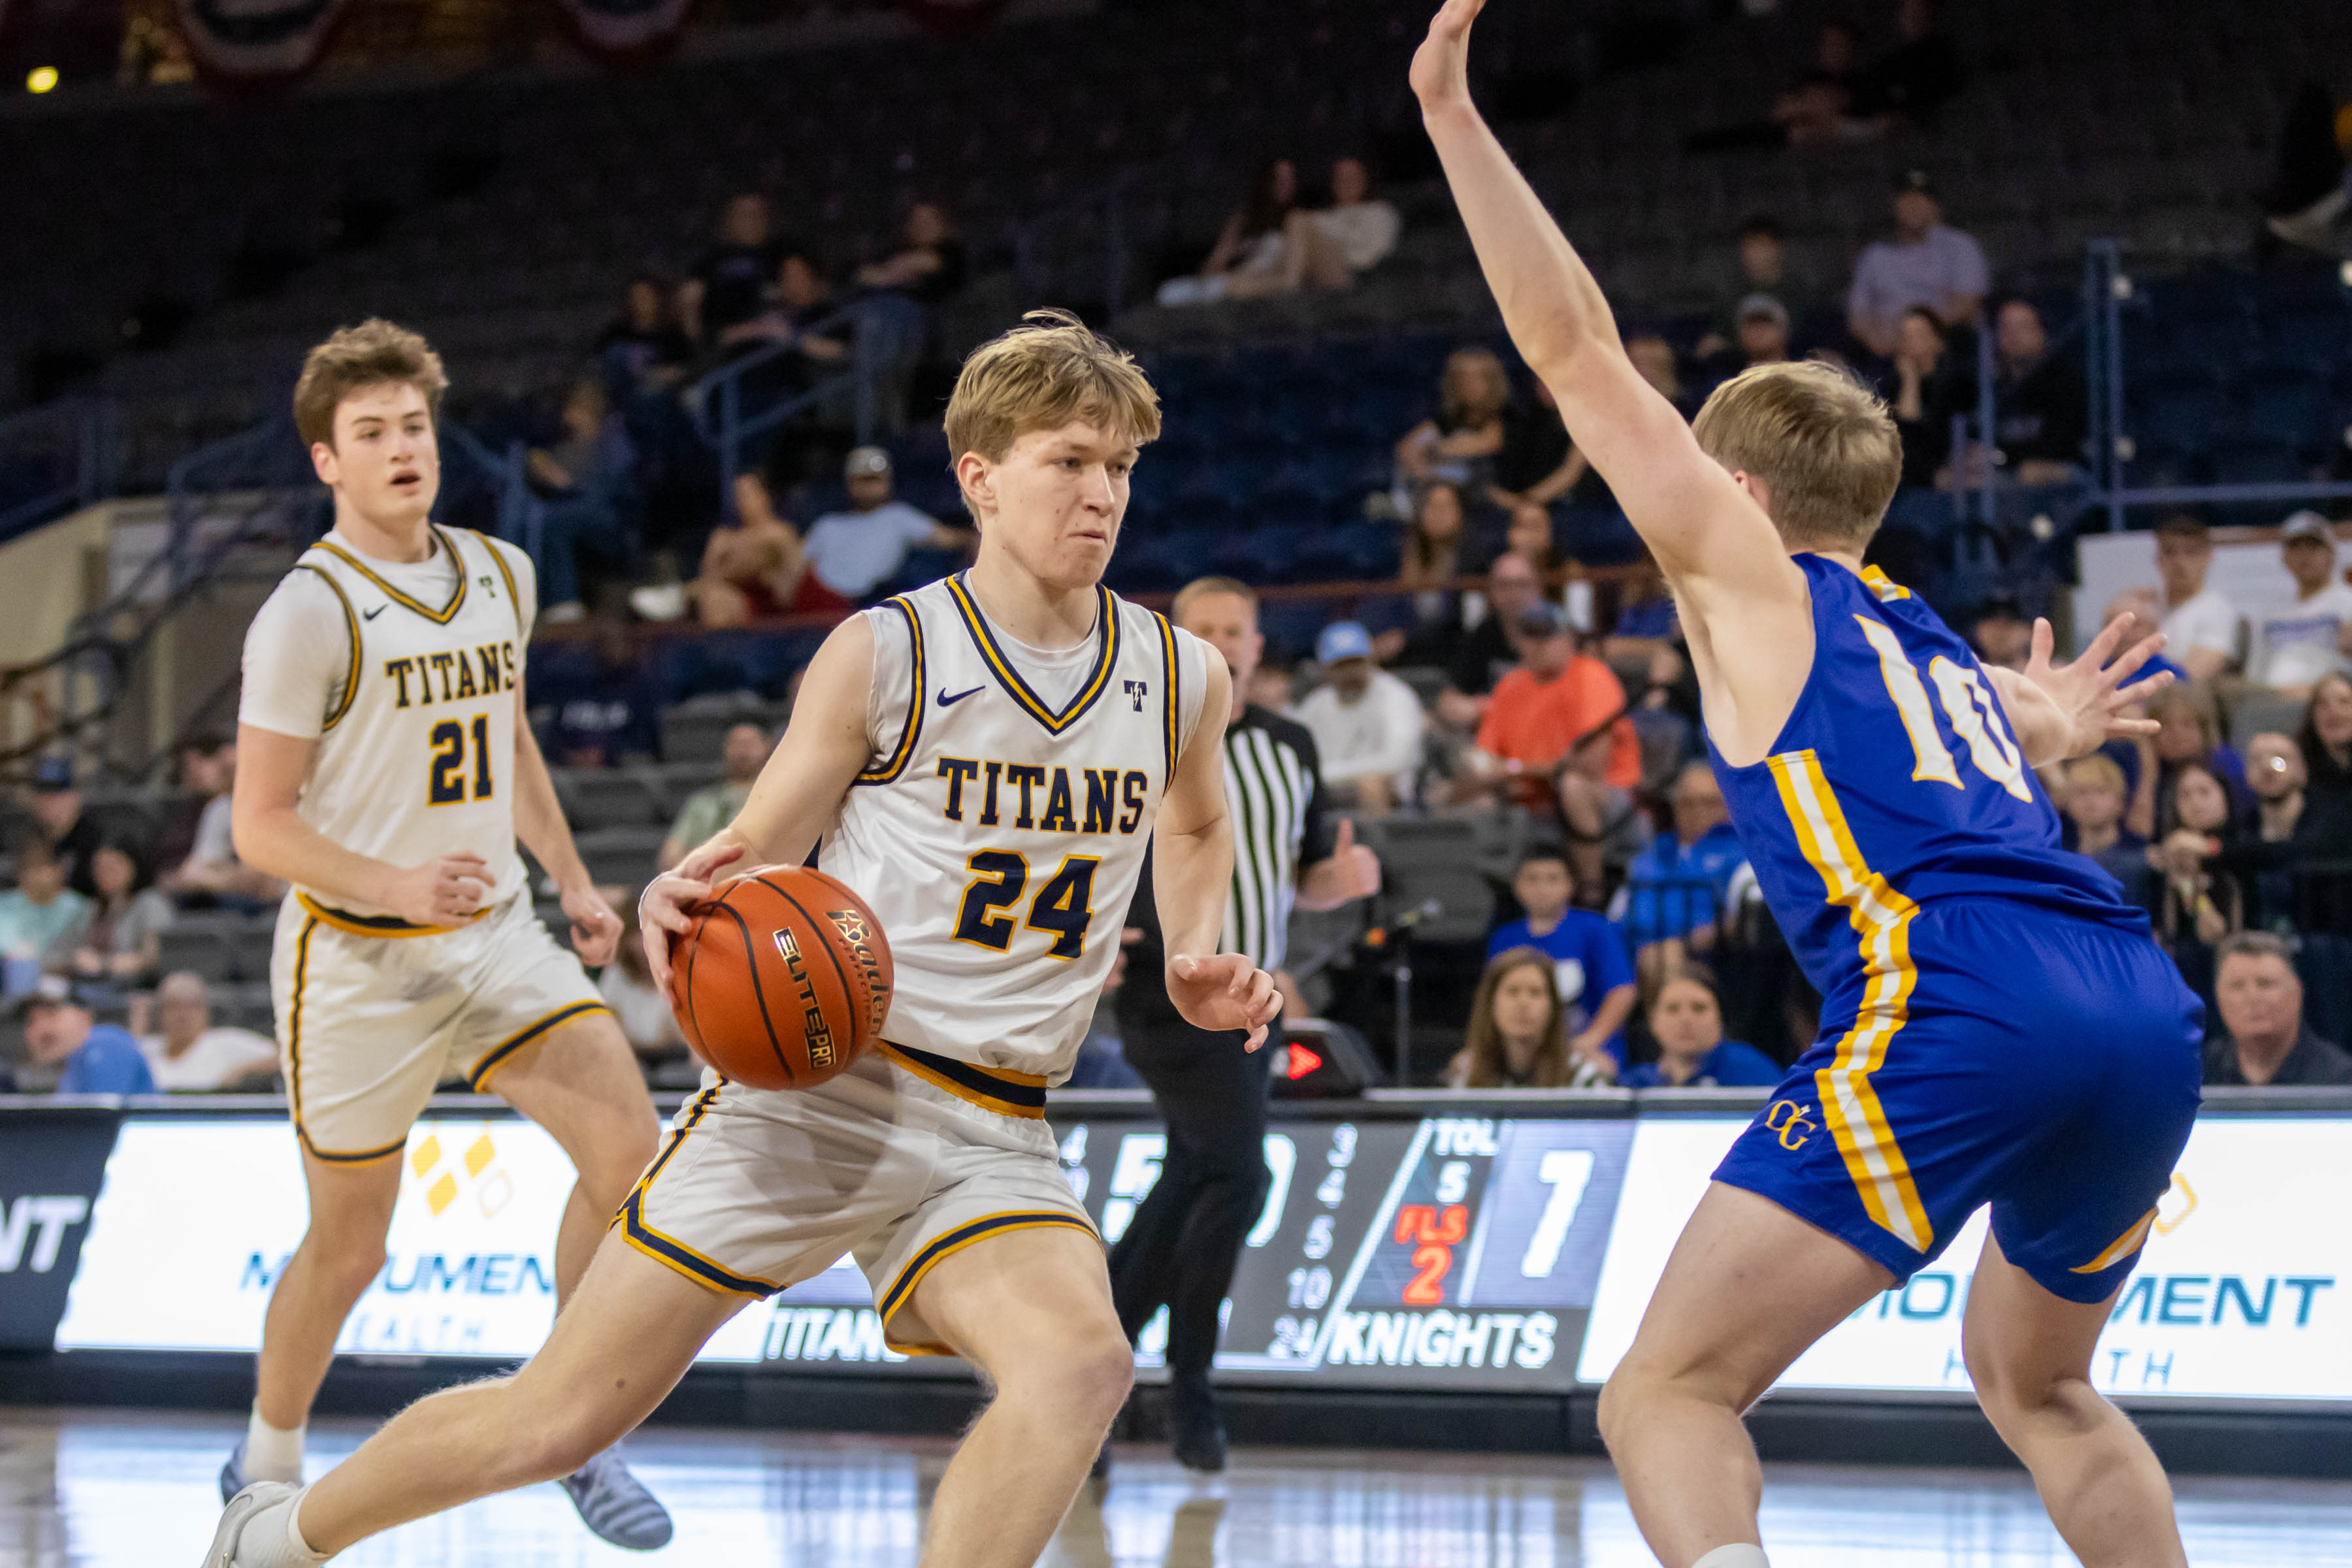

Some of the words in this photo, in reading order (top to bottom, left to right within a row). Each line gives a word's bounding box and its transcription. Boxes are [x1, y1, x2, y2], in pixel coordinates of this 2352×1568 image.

[384, 640, 516, 710] TITANS
[1853, 613, 2033, 803] 10
[426, 713, 494, 807] 21
[936, 756, 1148, 836] TITANS
[950, 847, 1102, 961] 24
[773, 926, 826, 1034] ELITE
[808, 1028, 834, 1070] PRO
[1435, 1161, 1471, 1205] 5
[1521, 1150, 1595, 1278] 7
[1394, 1205, 1469, 1245] FLS
[1287, 1266, 1333, 1309] 10
[1402, 1243, 1453, 1305] 2
[1328, 1309, 1558, 1369] KNIGHTS
